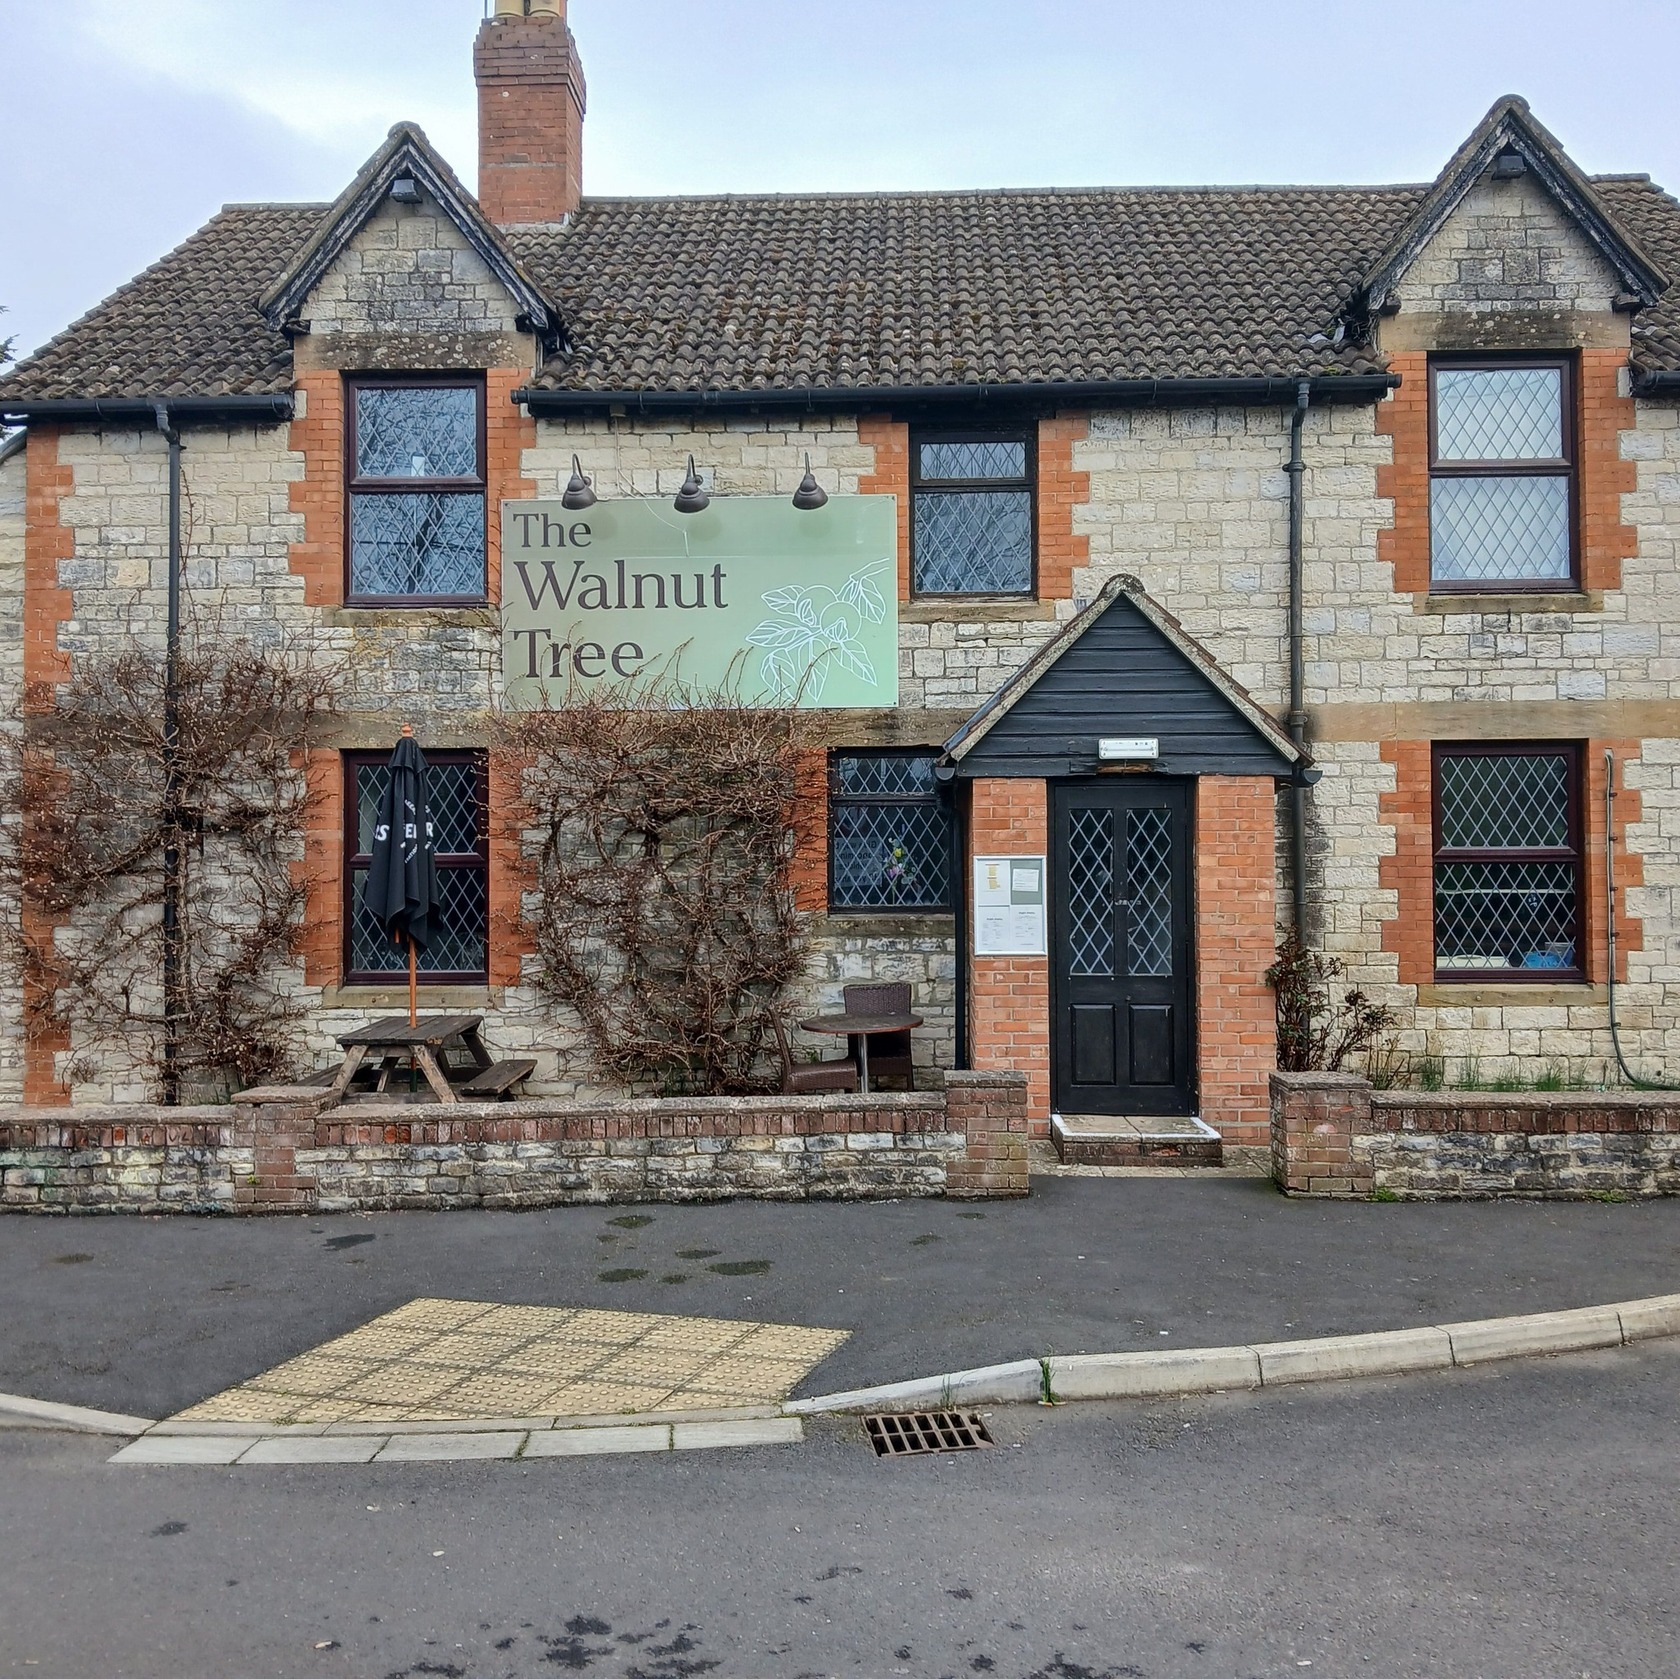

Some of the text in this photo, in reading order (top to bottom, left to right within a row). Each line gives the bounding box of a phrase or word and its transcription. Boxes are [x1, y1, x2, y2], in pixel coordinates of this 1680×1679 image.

[513, 513, 592, 548] The
[514, 560, 728, 611] Walnut
[514, 628, 644, 679] Tree
